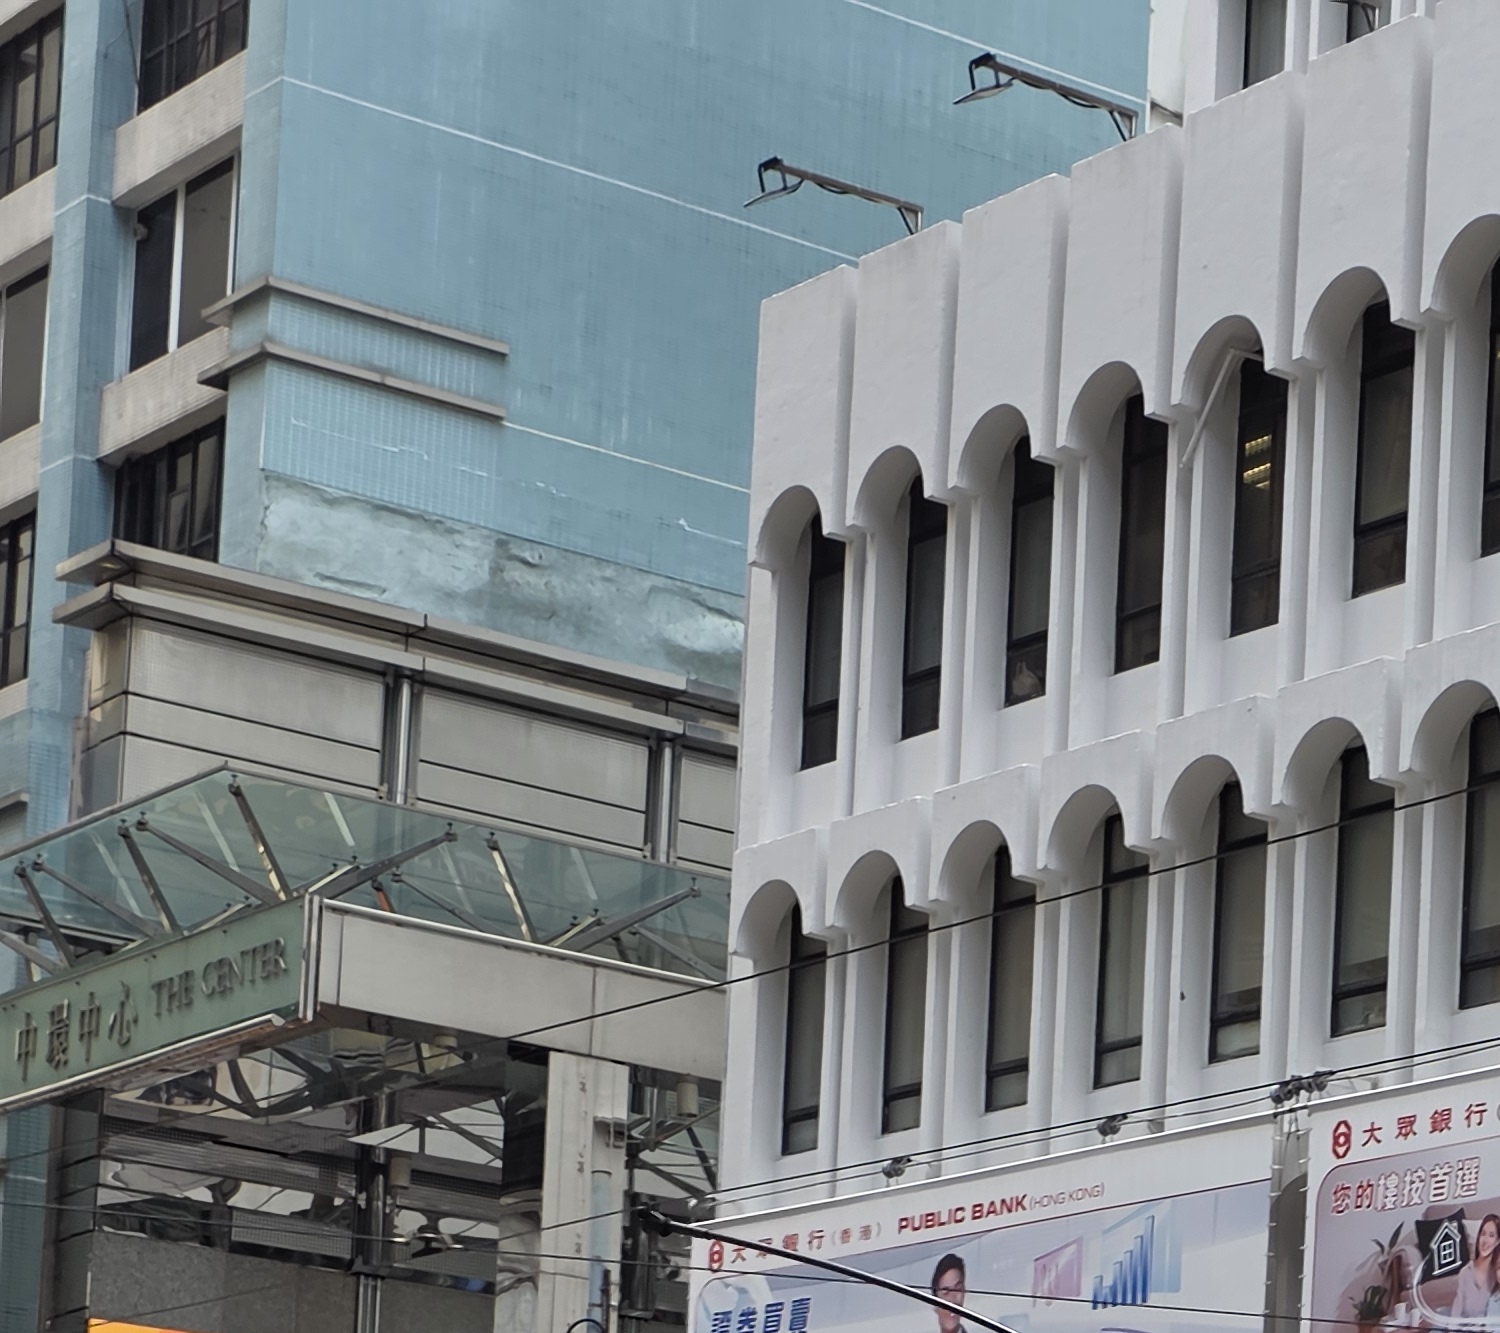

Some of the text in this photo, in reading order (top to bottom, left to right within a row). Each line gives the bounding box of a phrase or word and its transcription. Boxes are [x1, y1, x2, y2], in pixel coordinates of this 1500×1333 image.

[151, 937, 288, 1018] THE CENTER
[14, 981, 139, 1082] 中環中心
[898, 1182, 1105, 1235] PUBLIC BANK (HONG KONG)
[1331, 1156, 1481, 1215] 您的樓按首選
